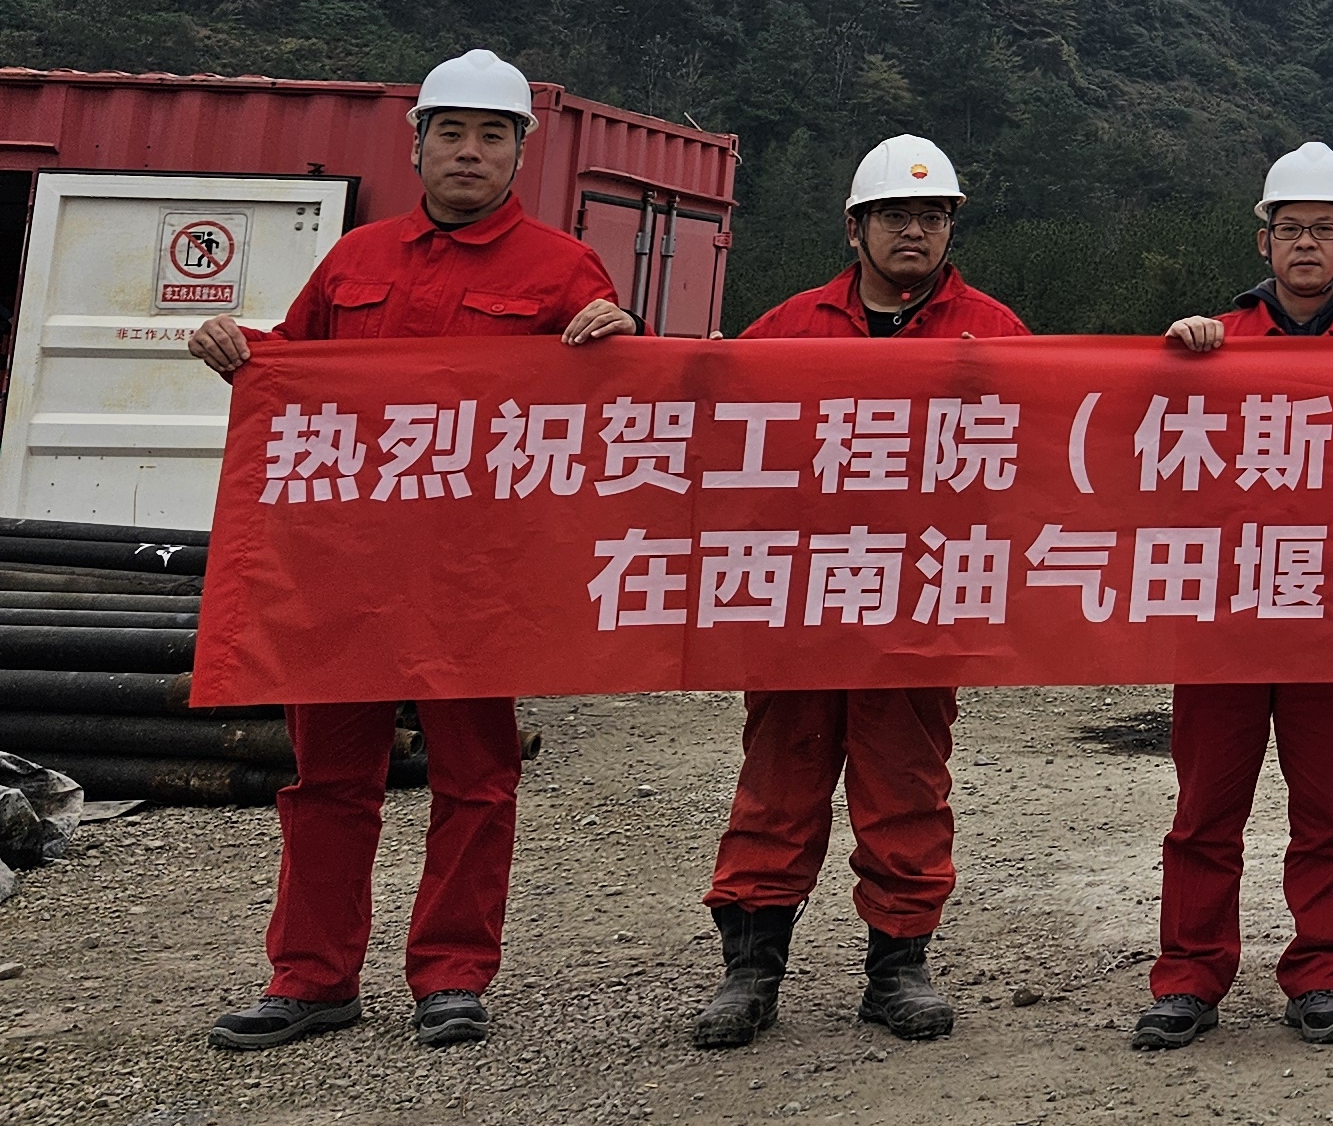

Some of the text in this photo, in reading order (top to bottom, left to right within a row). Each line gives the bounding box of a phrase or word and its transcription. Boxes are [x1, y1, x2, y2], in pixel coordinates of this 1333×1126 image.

[164, 286, 231, 301] 非工作人员禁止入内
